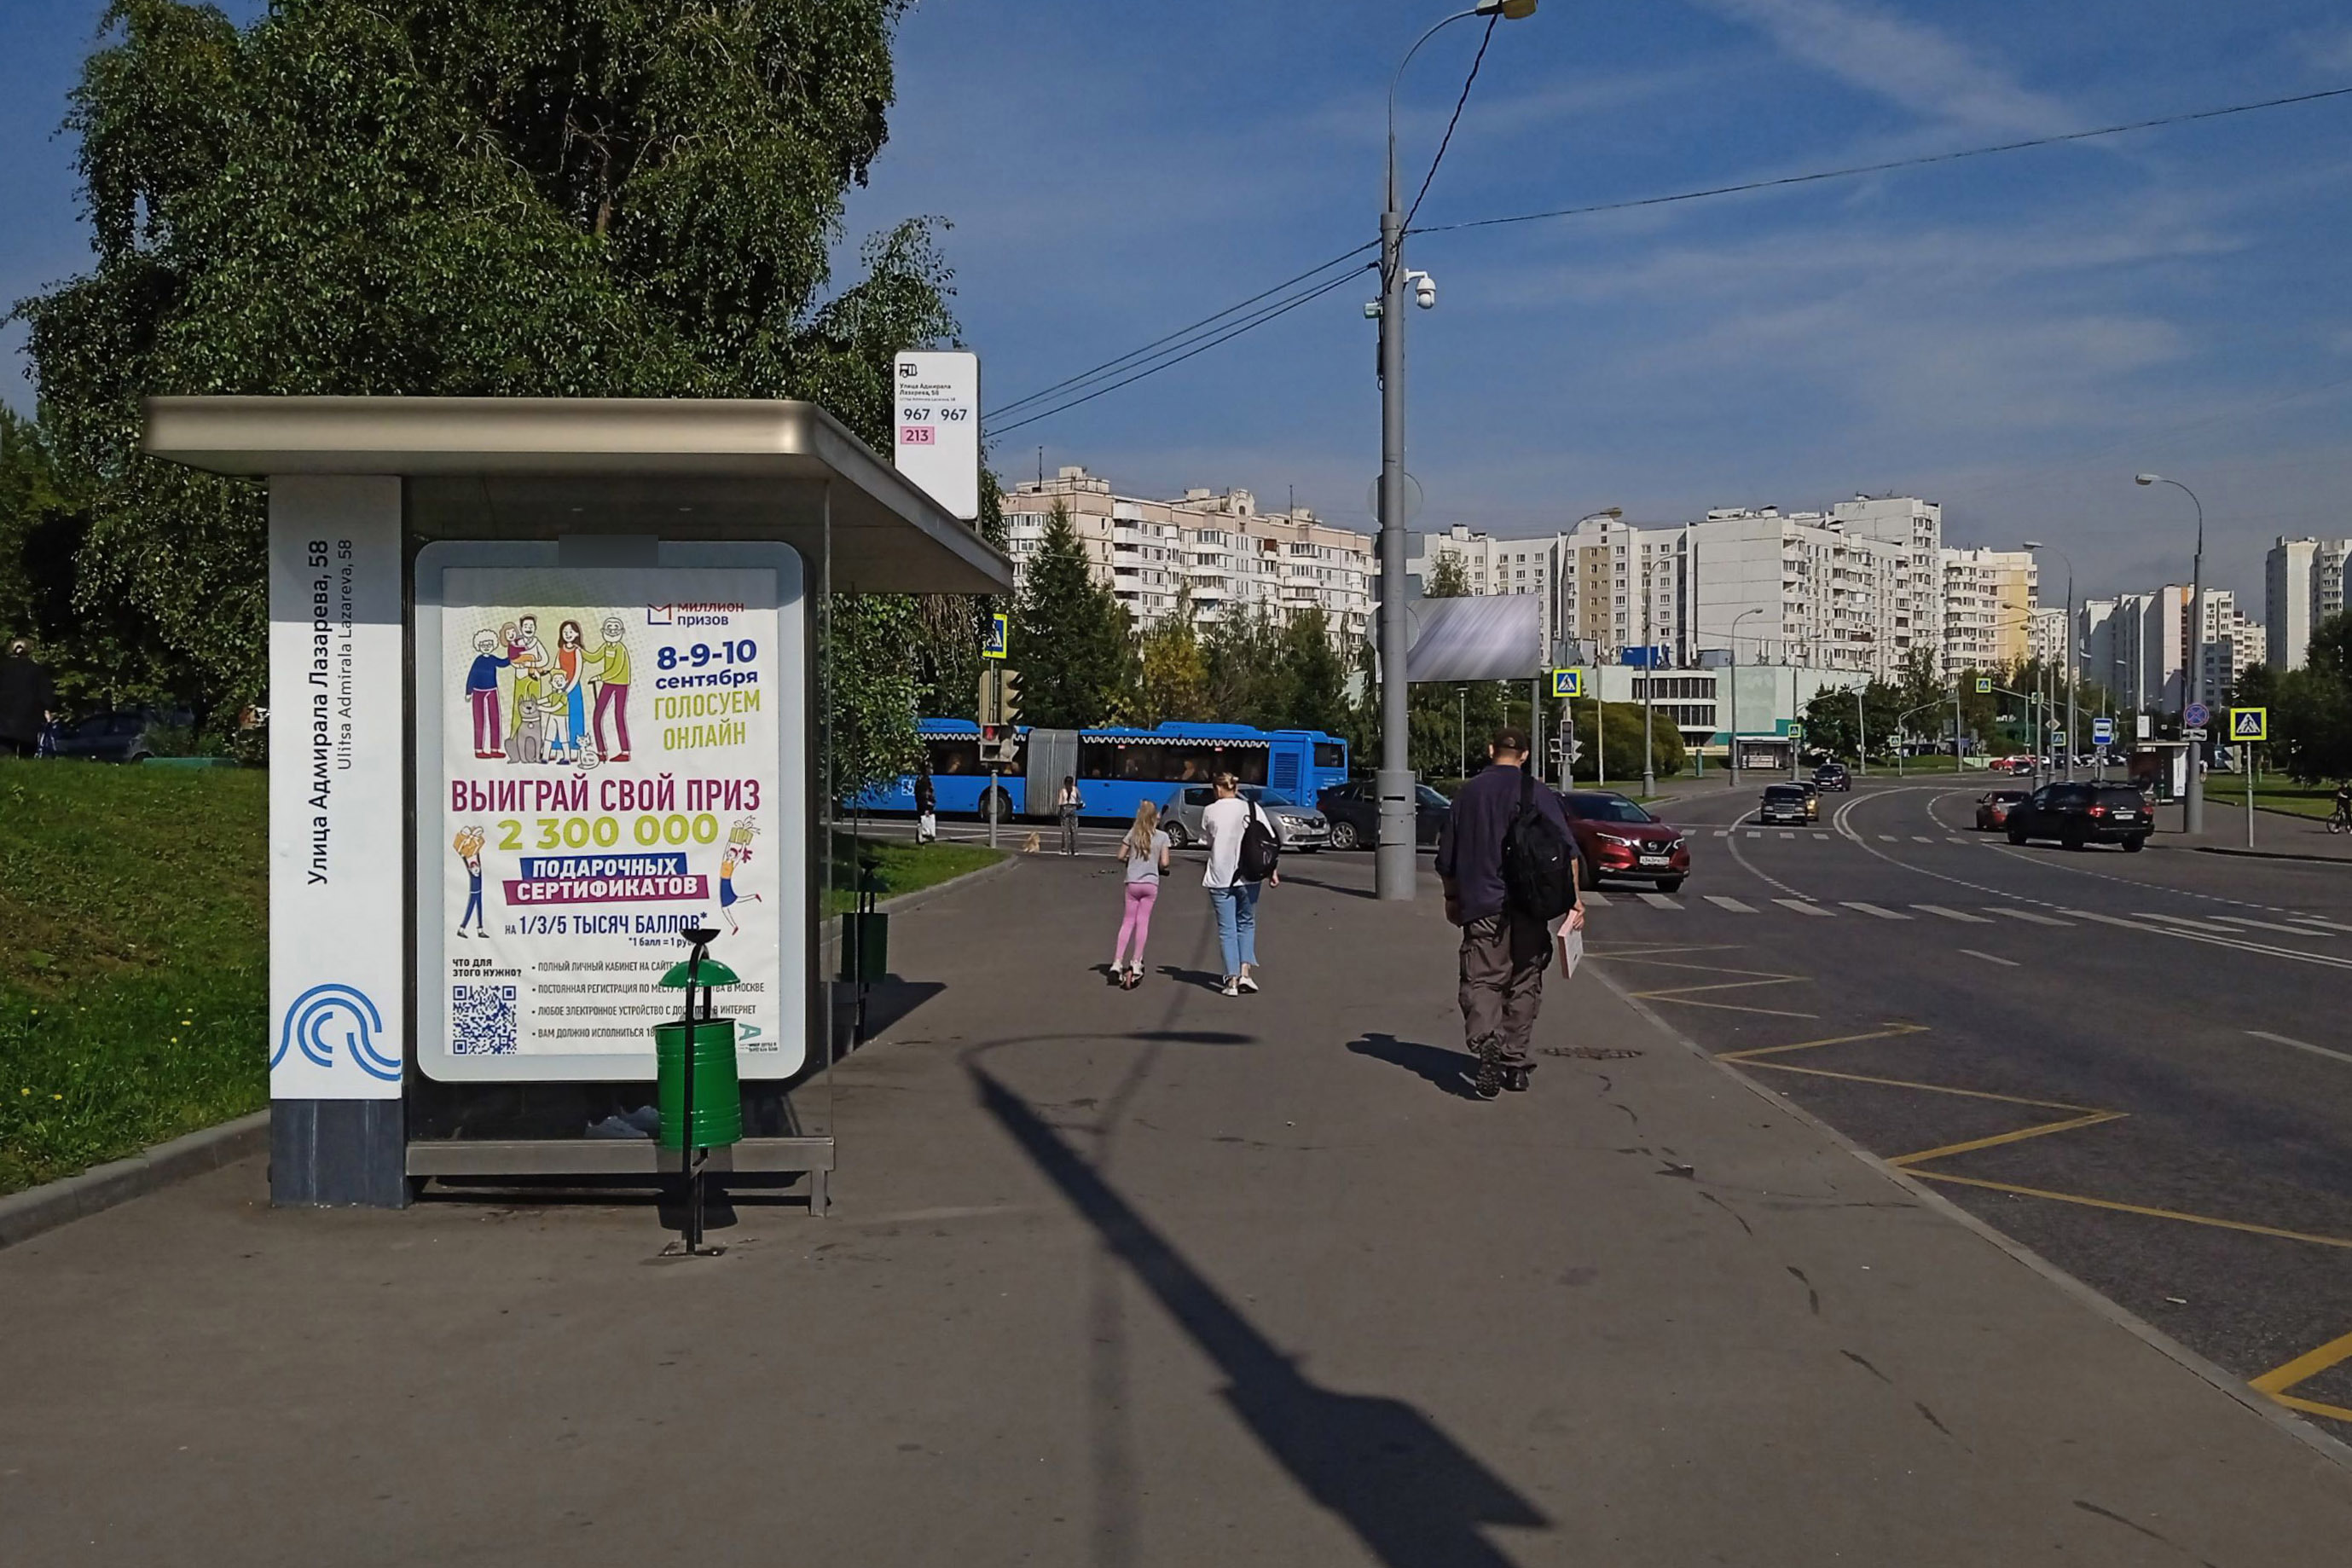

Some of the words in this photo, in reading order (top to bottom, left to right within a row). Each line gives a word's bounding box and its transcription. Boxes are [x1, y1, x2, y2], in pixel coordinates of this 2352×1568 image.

[904, 408, 930, 420] 967
[941, 408, 967, 421] 967
[906, 430, 929, 442] 213
[309, 541, 328, 568] 58
[338, 540, 351, 559] 58
[338, 564, 354, 638] Lazareva,
[309, 574, 333, 687] Лазарева,
[678, 616, 729, 628] призов
[657, 639, 757, 670] 8-9-10
[337, 644, 351, 718] Admirala
[656, 669, 758, 690] сентября
[655, 689, 760, 720] ГОЛОСУЕМ
[663, 718, 746, 750] ОНЛАЙН
[308, 694, 333, 809] Адмирала
[337, 723, 351, 770] Ulitsa
[452, 772, 588, 812] ВЫИГРАЙ
[600, 772, 675, 812] СВОЙ
[686, 779, 761, 811] ПРИЗ
[499, 819, 523, 851] 2
[536, 816, 619, 849] 300
[634, 813, 718, 847] 000
[308, 816, 330, 885] Улица
[532, 858, 677, 879] ПОДАРОЧНЫХ
[517, 877, 698, 901] СЕРТИФИКАТОВ
[505, 925, 517, 934] НА
[519, 915, 567, 934] 1/3/5
[573, 915, 629, 934] ТЫСЯЧ
[640, 937, 661, 946] балл
[453, 969, 481, 977] ЭТОГО
[484, 969, 522, 977] НУЖНО?
[472, 959, 492, 968] ДЛЯ
[538, 961, 570, 972] ПОЛНЫЙ
[571, 961, 604, 971] ЛИЧНЫЙ
[605, 962, 637, 972] КАБИНЕТ
[640, 962, 650, 971] НА
[652, 960, 674, 971] САЙТЕ
[538, 984, 586, 994] ПОСТОЯННАЯ
[588, 983, 638, 994] РЕГИСТРАЦИЯ
[640, 983, 650, 992] ПО
[734, 982, 764, 992] МОСКВЕ
[538, 1006, 565, 1015] ЛЮБОЕ
[565, 1005, 617, 1015] ЭЛЕКТРОННОЕ
[619, 1004, 663, 1015] УСТРОЙСТВО
[665, 1006, 671, 1015] С
[720, 1005, 756, 1015] ИНТЕРНЕТ
[538, 1028, 554, 1038] ВАМ
[556, 1028, 590, 1039] ДОЛЖНО
[592, 1027, 644, 1038] ИСПОЛНИТЬСЯ
